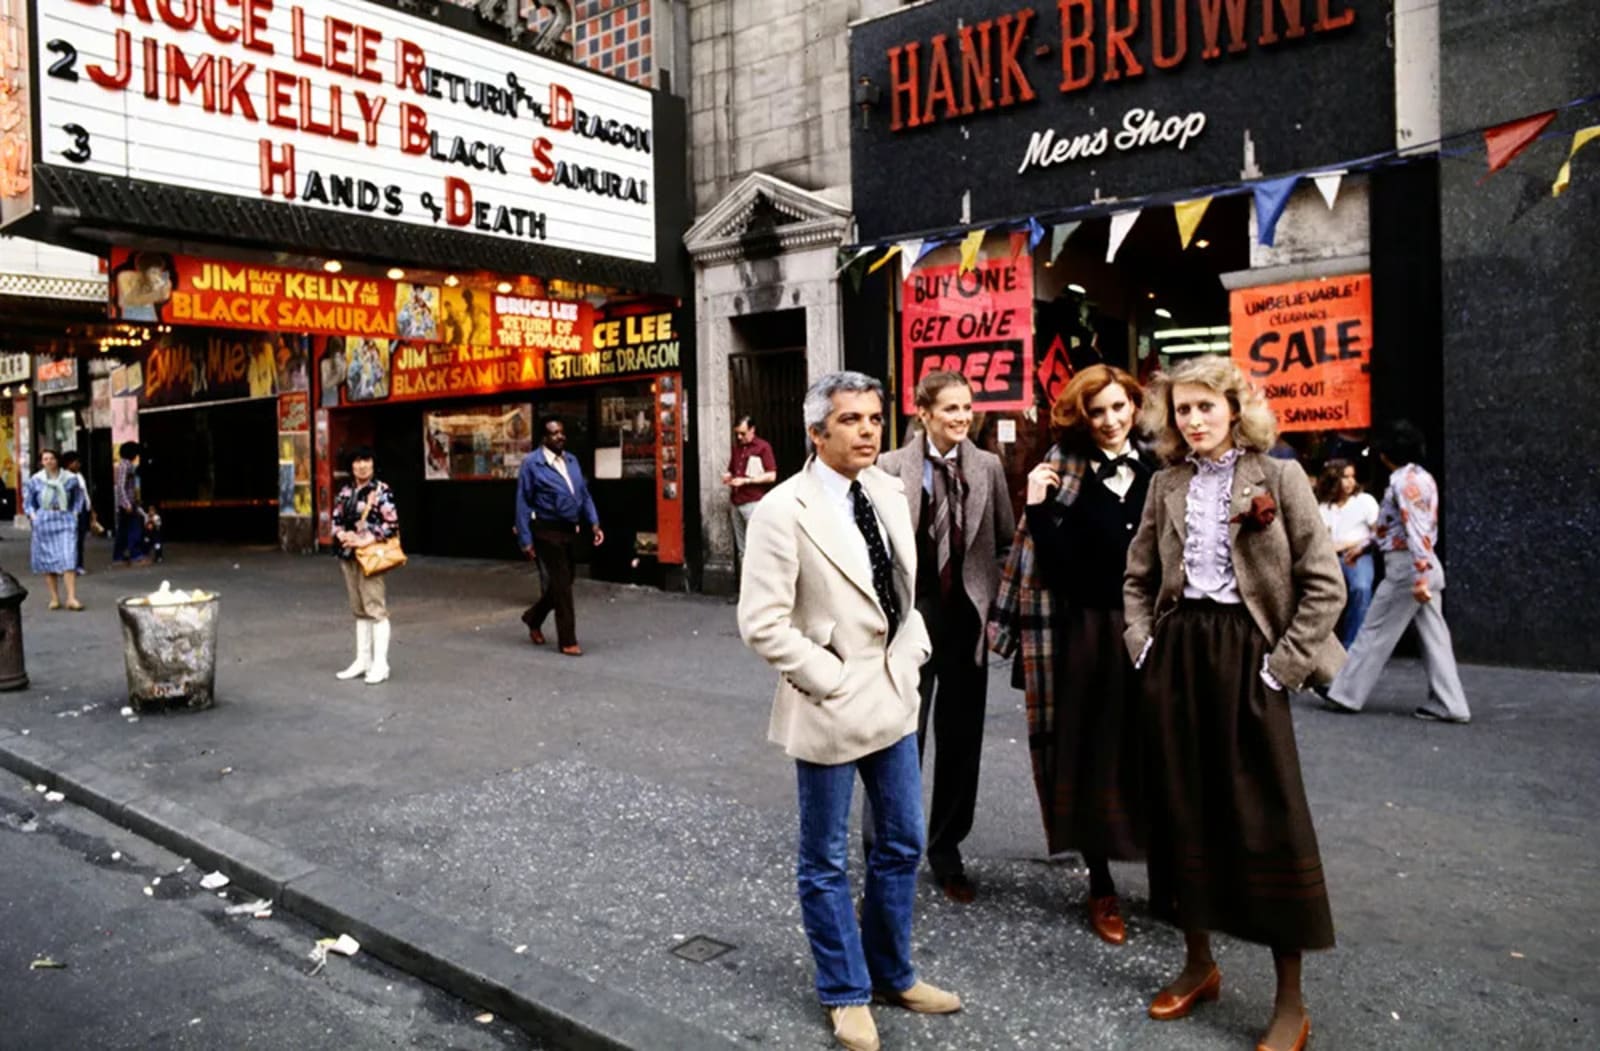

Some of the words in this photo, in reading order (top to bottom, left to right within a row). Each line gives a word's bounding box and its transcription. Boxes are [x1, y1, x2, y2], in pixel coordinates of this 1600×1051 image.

[292, 6, 383, 84] LEE
[395, 38, 517, 119] RETURN
[548, 82, 651, 154] DRAGON
[46, 38, 79, 83] 2
[400, 101, 508, 175] BLACK
[530, 136, 648, 205] SAMURAI
[1113, 107, 1207, 151] Shop
[61, 123, 92, 163] 3
[258, 138, 404, 217] HANDS
[444, 175, 547, 241] DEATH
[191, 263, 247, 293] JIM
[285, 273, 360, 304] KELLY
[362, 281, 379, 294] AS
[914, 274, 952, 303] BUY
[956, 265, 1017, 299] ONE
[1244, 280, 1361, 317] UNBELIEVABLE!
[172, 291, 272, 326] BLACK
[278, 301, 397, 335] SAMURAI
[495, 295, 551, 318] BRUCE
[551, 301, 578, 321] LEE
[498, 314, 553, 332] RETURN
[555, 320, 574, 334] OF
[909, 315, 951, 343] GET
[956, 309, 1016, 339] ONE
[496, 328, 522, 347] THE
[524, 331, 583, 351] DRAGON
[626, 312, 673, 345] LEE
[397, 345, 427, 371] JIM
[548, 350, 601, 381] RETURN
[615, 341, 681, 374] DRAGON
[1248, 318, 1363, 378] SALE
[392, 367, 448, 396] BLACK
[450, 356, 545, 388] SAMURAI
[1300, 380, 1326, 397] OUT
[1284, 399, 1350, 424] SAVINGS!
